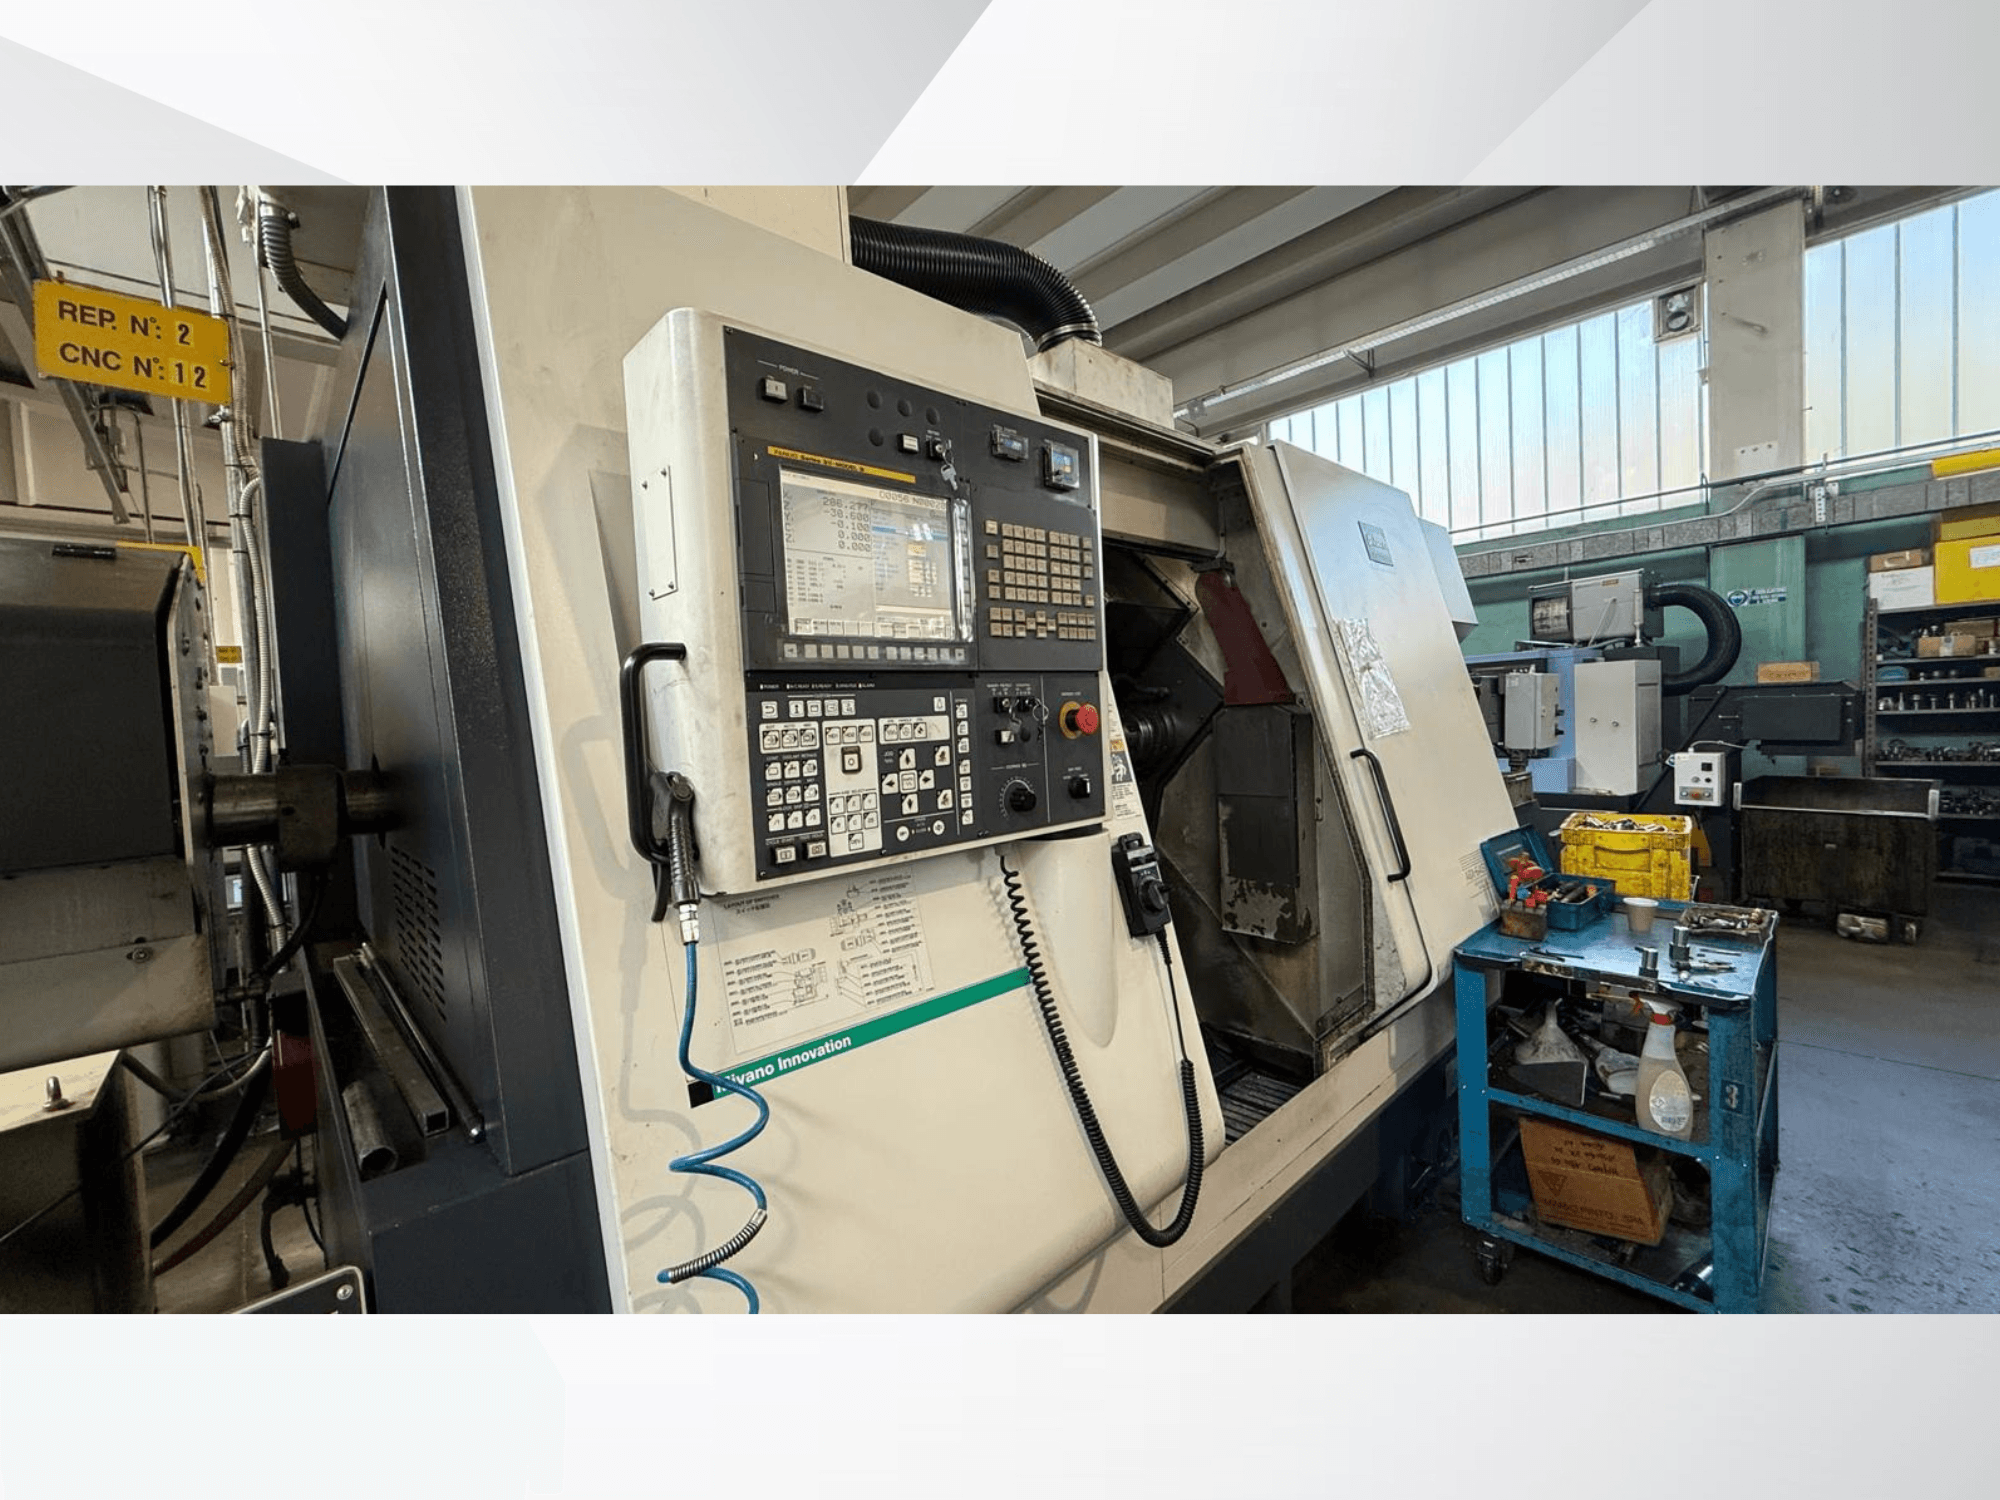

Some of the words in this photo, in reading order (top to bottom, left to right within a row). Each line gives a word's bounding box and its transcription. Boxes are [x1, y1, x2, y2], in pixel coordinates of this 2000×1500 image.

[58, 299, 117, 331] REP.
[177, 323, 190, 346] 2
[59, 342, 122, 371] CNC
[838, 529, 871, 542] 0.000
[838, 540, 871, 552] 0.000
[777, 1035, 852, 1072] Innovation
[1725, 1084, 1739, 1109] 3
